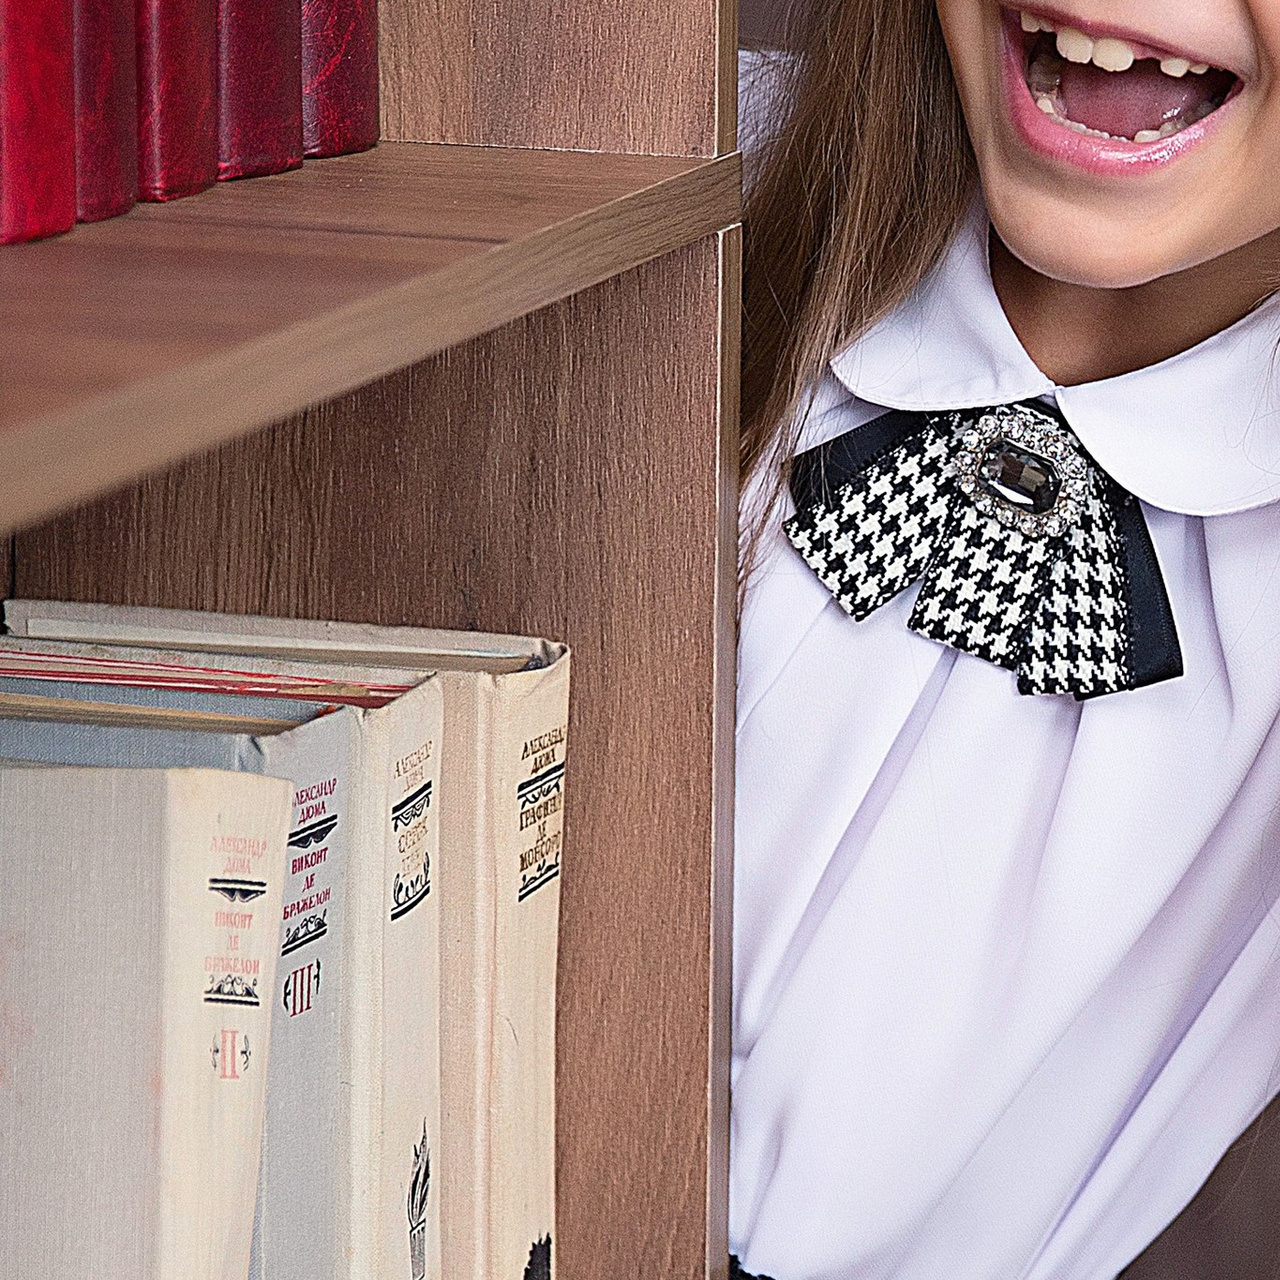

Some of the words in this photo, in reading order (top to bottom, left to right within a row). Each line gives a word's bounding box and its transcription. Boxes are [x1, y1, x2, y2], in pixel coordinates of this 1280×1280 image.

[294, 777, 338, 808] ЛЕКСАНДР
[298, 800, 327, 825] ДЮМА
[291, 846, 329, 876] ВИКОНТ
[301, 872, 315, 894] ДЕ
[282, 886, 331, 921] БРАЖЕЛОН
[289, 963, 314, 1018] III
